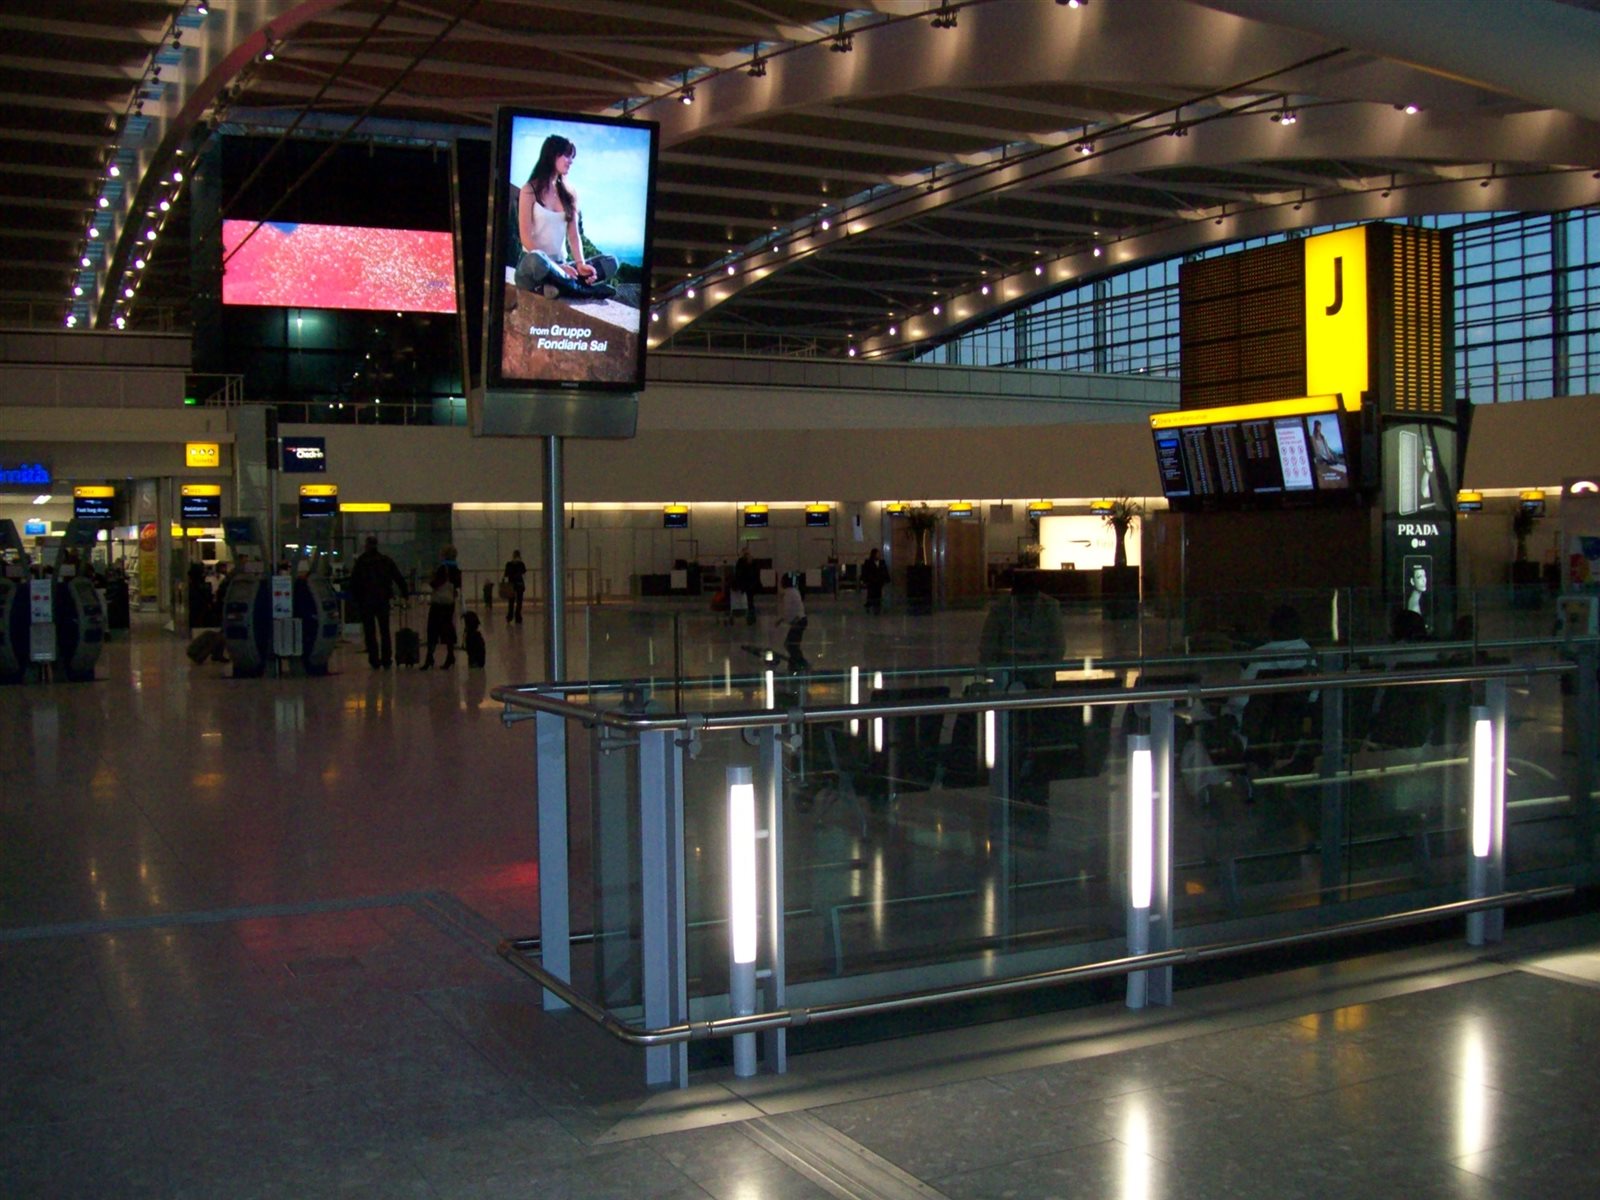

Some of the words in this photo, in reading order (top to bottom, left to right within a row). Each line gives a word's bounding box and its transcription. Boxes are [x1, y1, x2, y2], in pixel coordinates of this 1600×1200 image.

[1325, 256, 1343, 317] J
[530, 326, 549, 335] from
[551, 325, 591, 338] Gruppo
[537, 338, 588, 351] Fondiaria
[590, 341, 607, 352] Sai
[1398, 524, 1439, 536] PRADA
